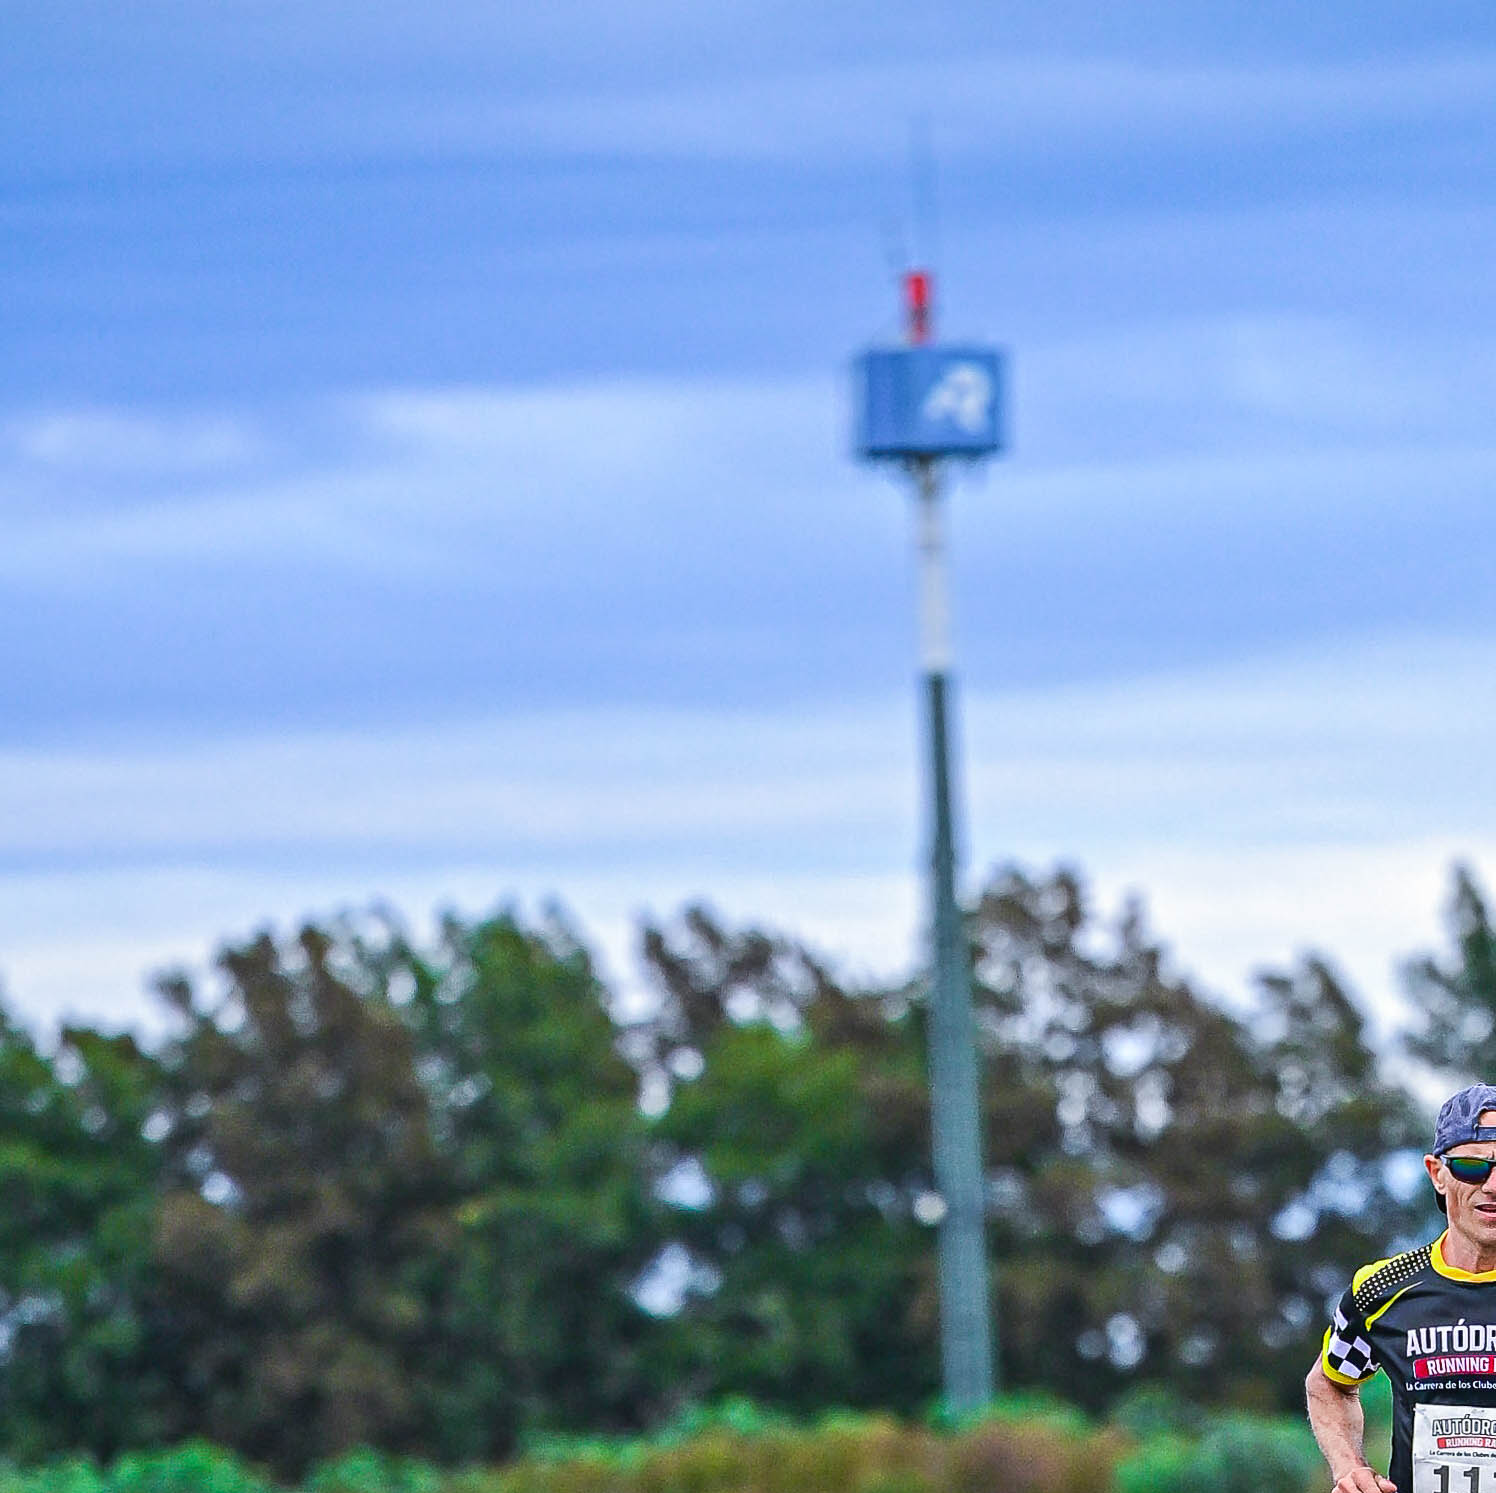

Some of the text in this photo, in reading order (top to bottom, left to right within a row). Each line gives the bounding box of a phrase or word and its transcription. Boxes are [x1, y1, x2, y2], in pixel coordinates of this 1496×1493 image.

[1427, 1357, 1490, 1376] RUNNING
[1414, 1381, 1444, 1391] Carrera
[1445, 1379, 1457, 1389] de
[1458, 1380, 1472, 1389] los
[1445, 1438, 1483, 1448] RUNNING
